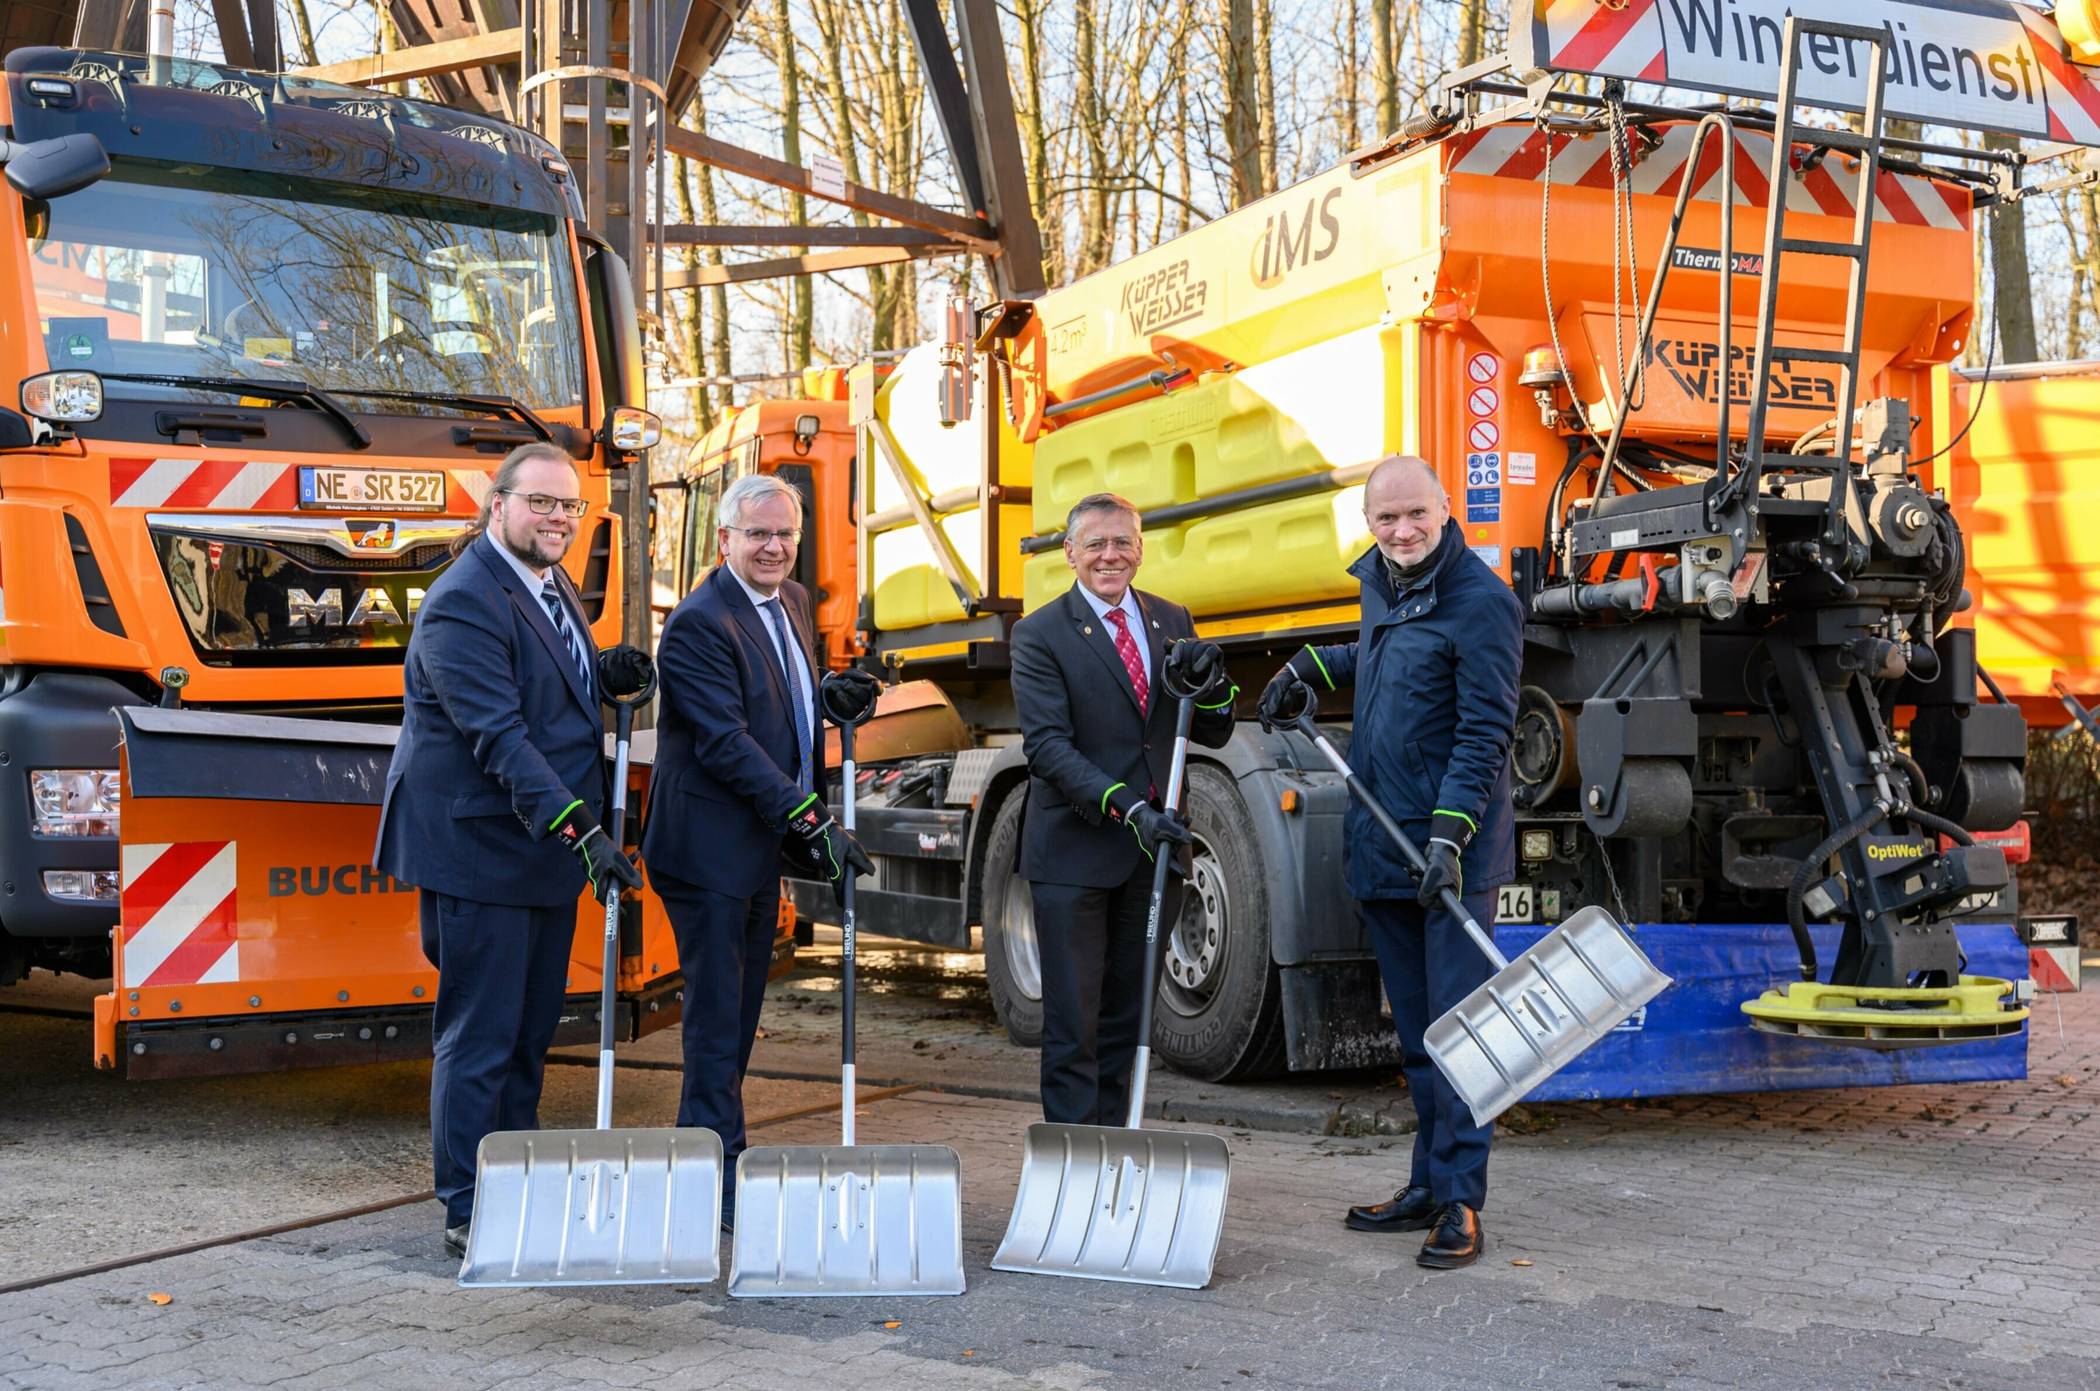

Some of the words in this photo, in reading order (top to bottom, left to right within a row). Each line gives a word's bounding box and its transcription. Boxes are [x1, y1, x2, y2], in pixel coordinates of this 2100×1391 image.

[1668, 0, 2032, 104] Winerdienst
[316, 473, 348, 499] NE
[364, 474, 394, 500] SR
[400, 476, 441, 501] 527
[1867, 845, 1924, 861] OptiWet
[1147, 906, 1156, 937] FREUND
